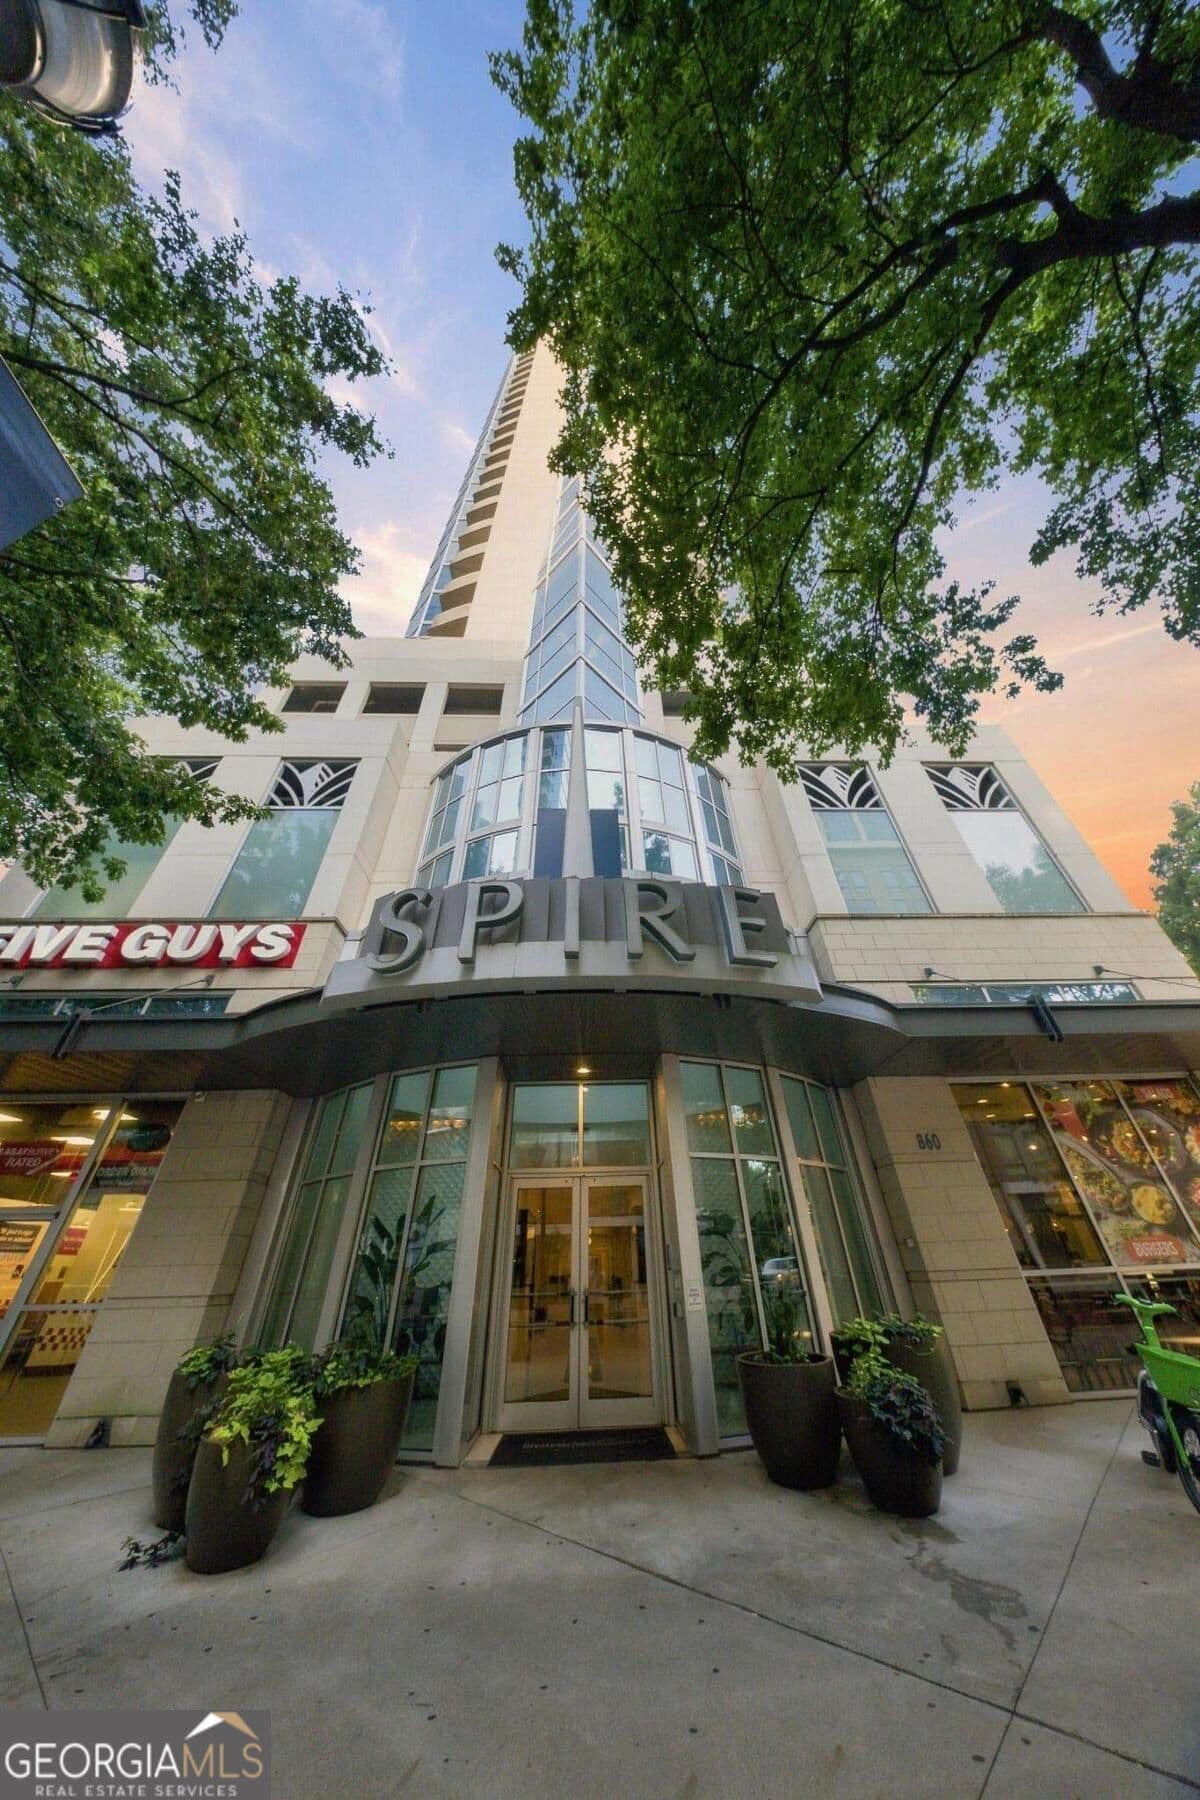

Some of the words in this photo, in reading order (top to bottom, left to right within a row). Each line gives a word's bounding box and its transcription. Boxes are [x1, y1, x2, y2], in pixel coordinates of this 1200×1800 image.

[120, 923, 295, 963] GUYS
[367, 878, 778, 975] SPIRE
[1132, 1240, 1179, 1257] BURGERS
